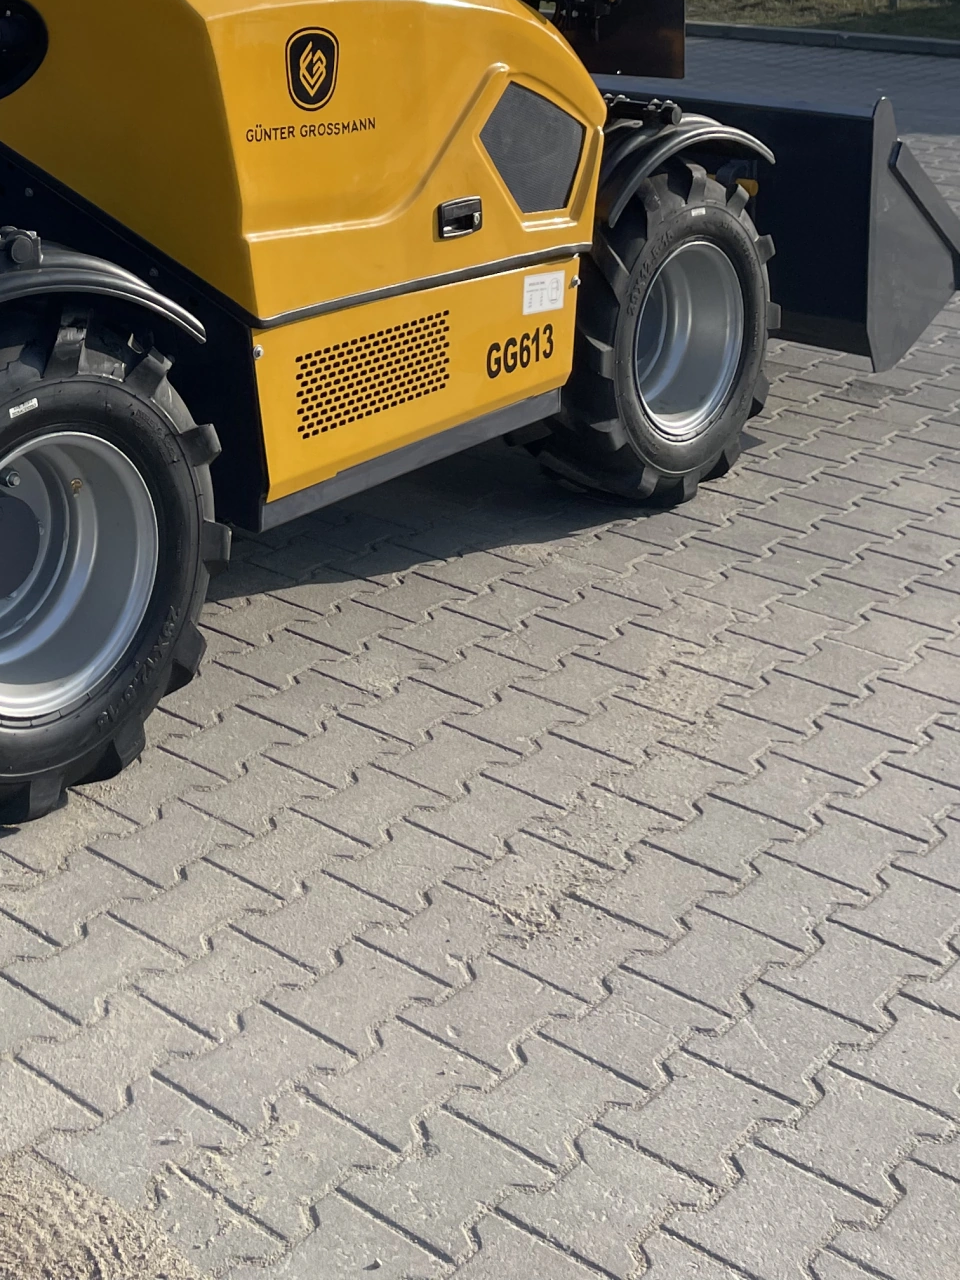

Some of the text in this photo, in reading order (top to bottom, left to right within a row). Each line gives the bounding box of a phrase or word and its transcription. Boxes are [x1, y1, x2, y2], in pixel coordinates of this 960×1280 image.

[245, 117, 376, 143] GÜNTER GROSSMANN
[486, 323, 554, 379] GG613
